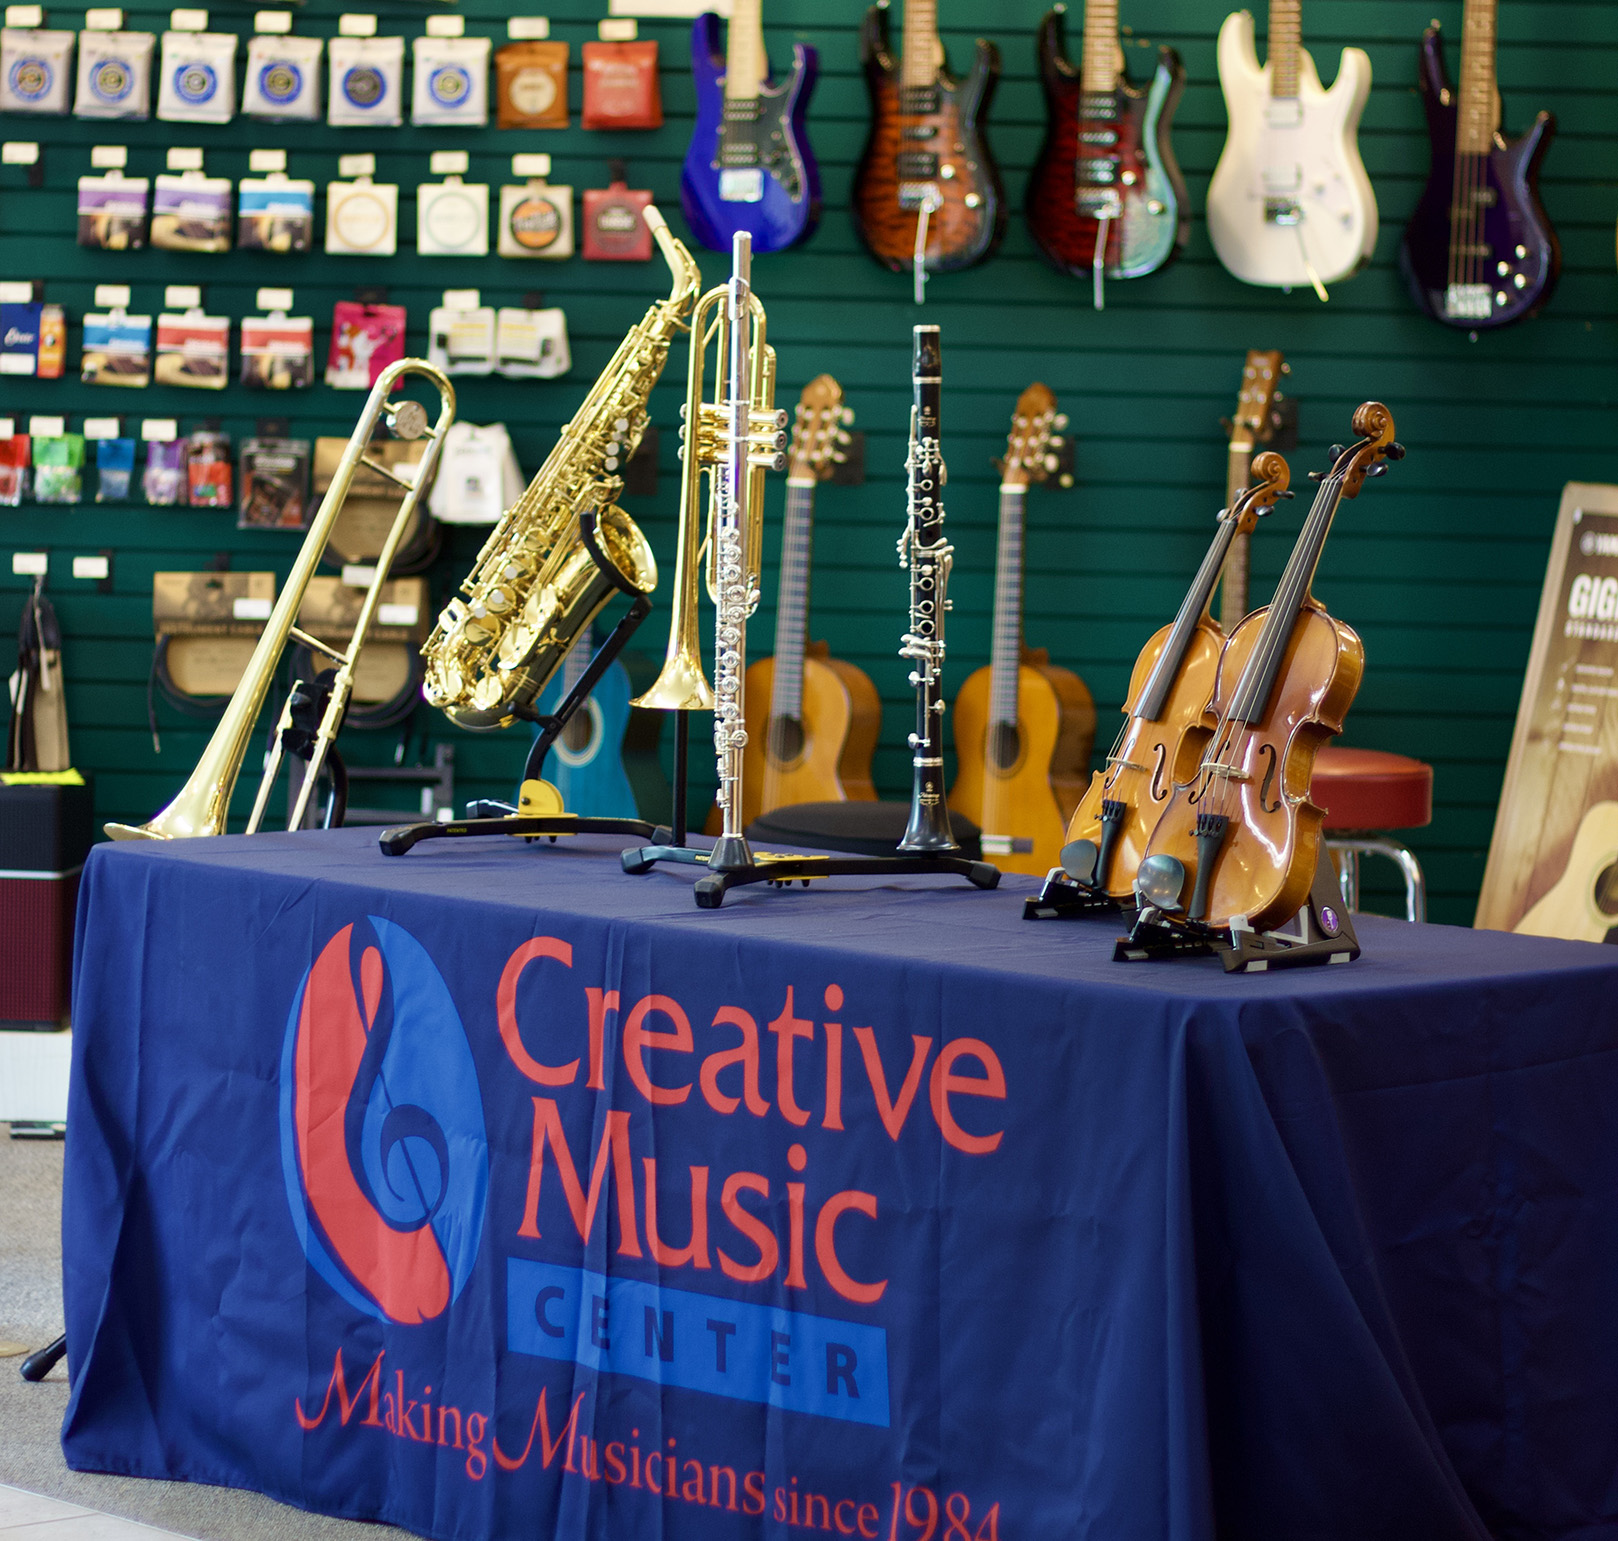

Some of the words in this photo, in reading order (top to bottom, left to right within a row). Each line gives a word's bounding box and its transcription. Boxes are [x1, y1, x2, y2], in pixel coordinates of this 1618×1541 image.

[1568, 573, 1618, 622] GIG
[496, 936, 1007, 1154] Creative
[517, 1096, 888, 1303] Music
[534, 1285, 860, 1399] CENTER
[295, 1347, 488, 1481] Making
[493, 1386, 766, 1515] Musicians
[773, 1476, 879, 1539] since
[888, 1481, 1000, 1541] 1984
